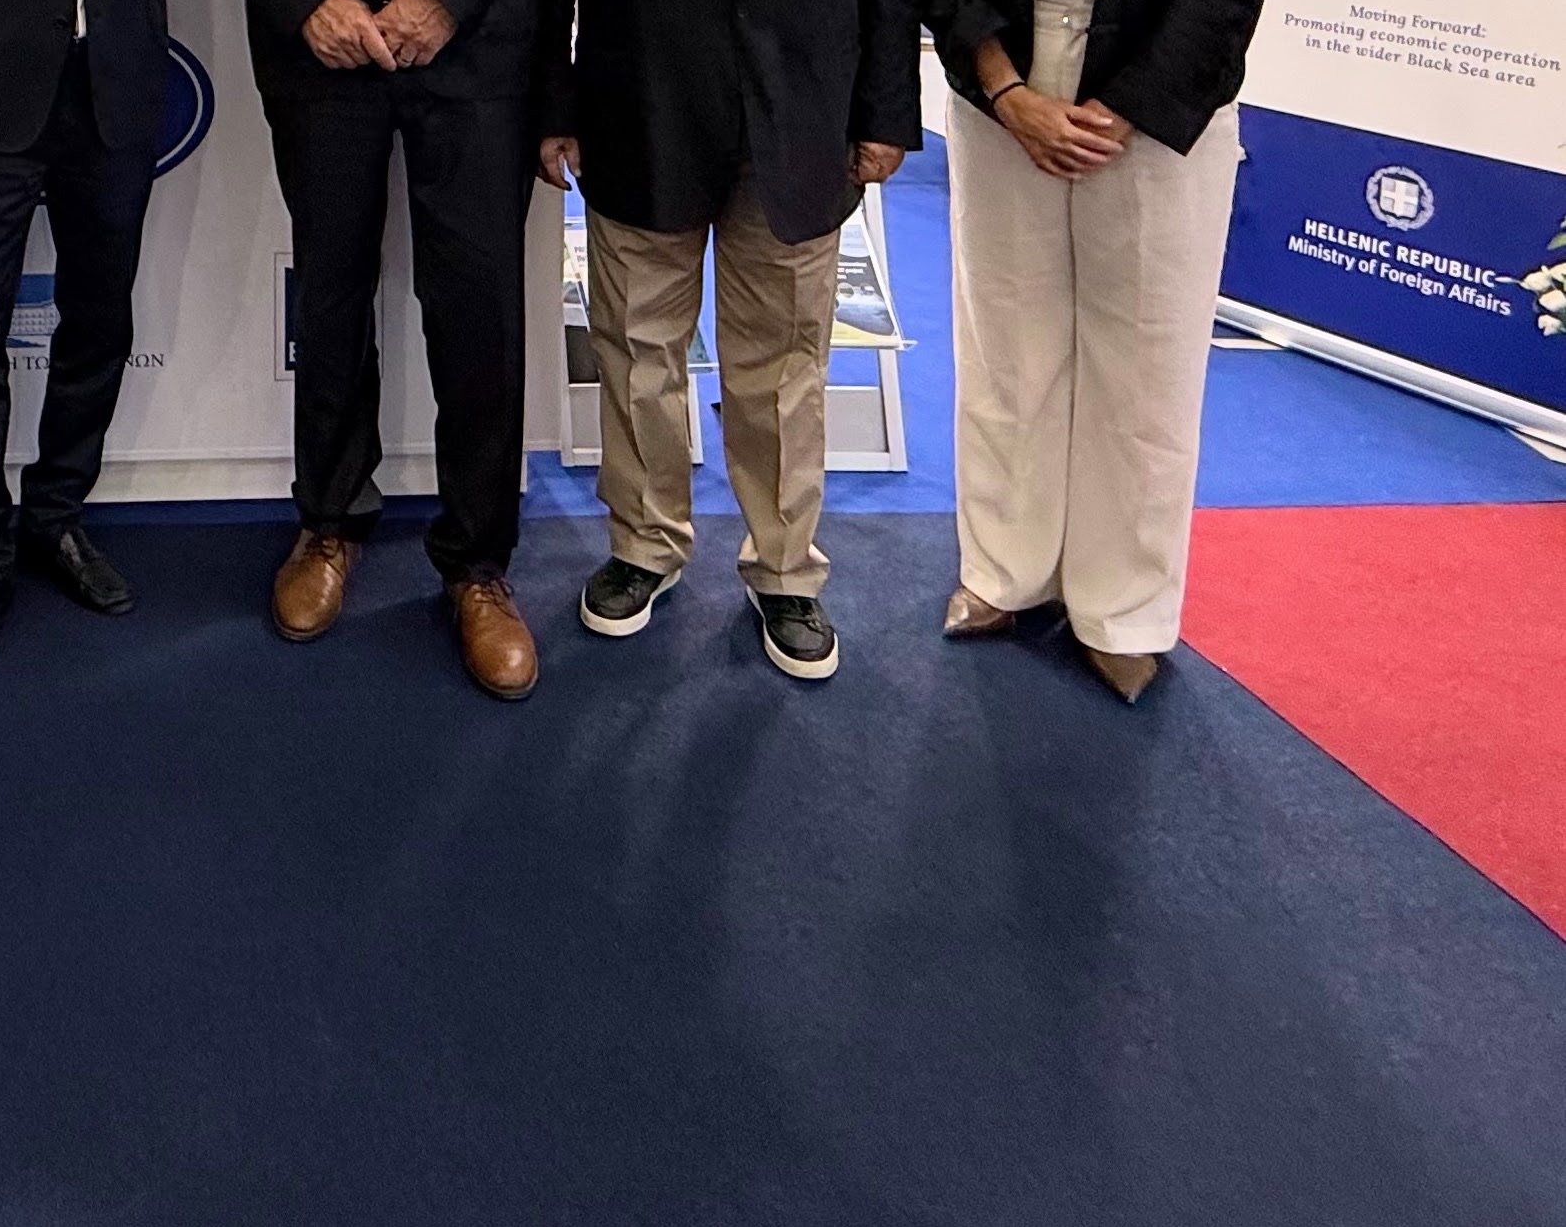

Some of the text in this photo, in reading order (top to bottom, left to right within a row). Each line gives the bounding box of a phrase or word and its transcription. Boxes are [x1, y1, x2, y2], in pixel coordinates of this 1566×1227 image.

[1284, 13, 1561, 72] Promoting economic cooperation
[1349, 5, 1488, 38] Moving Forward:
[1305, 34, 1536, 87] in the wider Black Sea area
[1288, 235, 1512, 316] Ministry of Foreign Affairs
[1304, 218, 1497, 288] HELLENIC REPUBLIC
